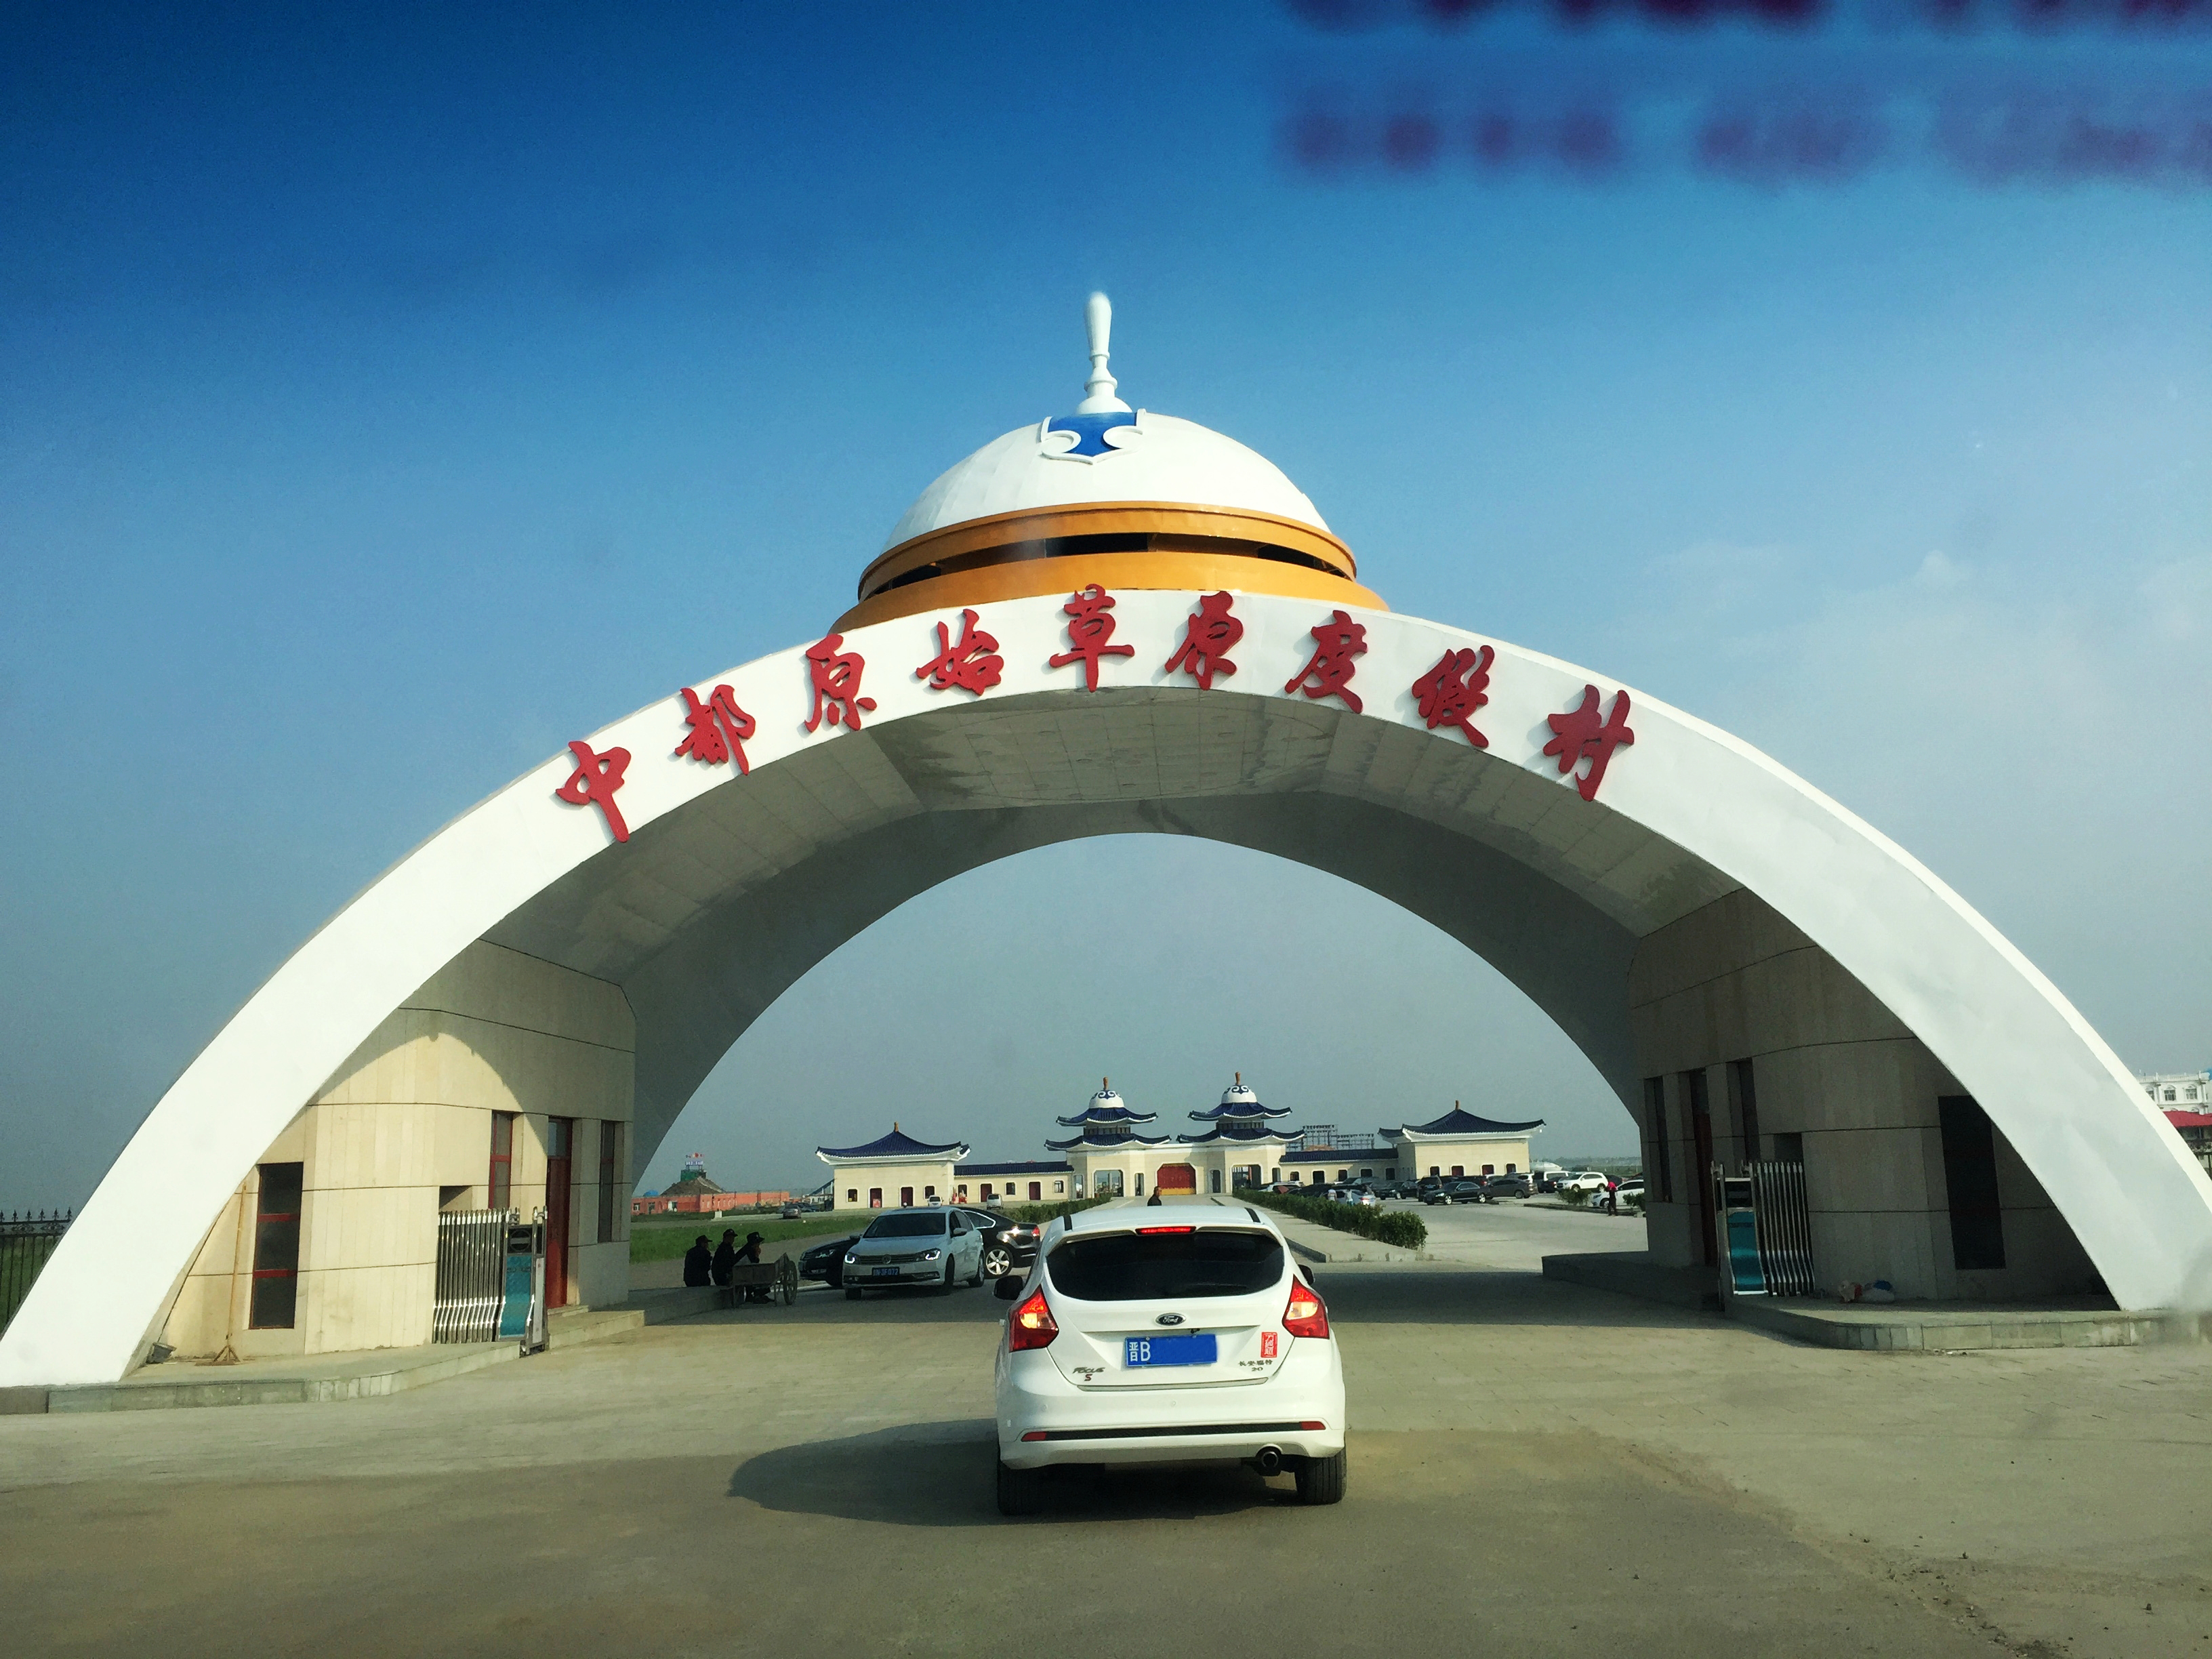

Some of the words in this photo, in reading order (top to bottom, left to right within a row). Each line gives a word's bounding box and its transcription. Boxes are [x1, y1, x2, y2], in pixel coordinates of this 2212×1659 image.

[555, 583, 1635, 844] 中都原始草原度假村
[1163, 1315, 1179, 1324] Ford
[1129, 1341, 1151, 1361] 晋B
